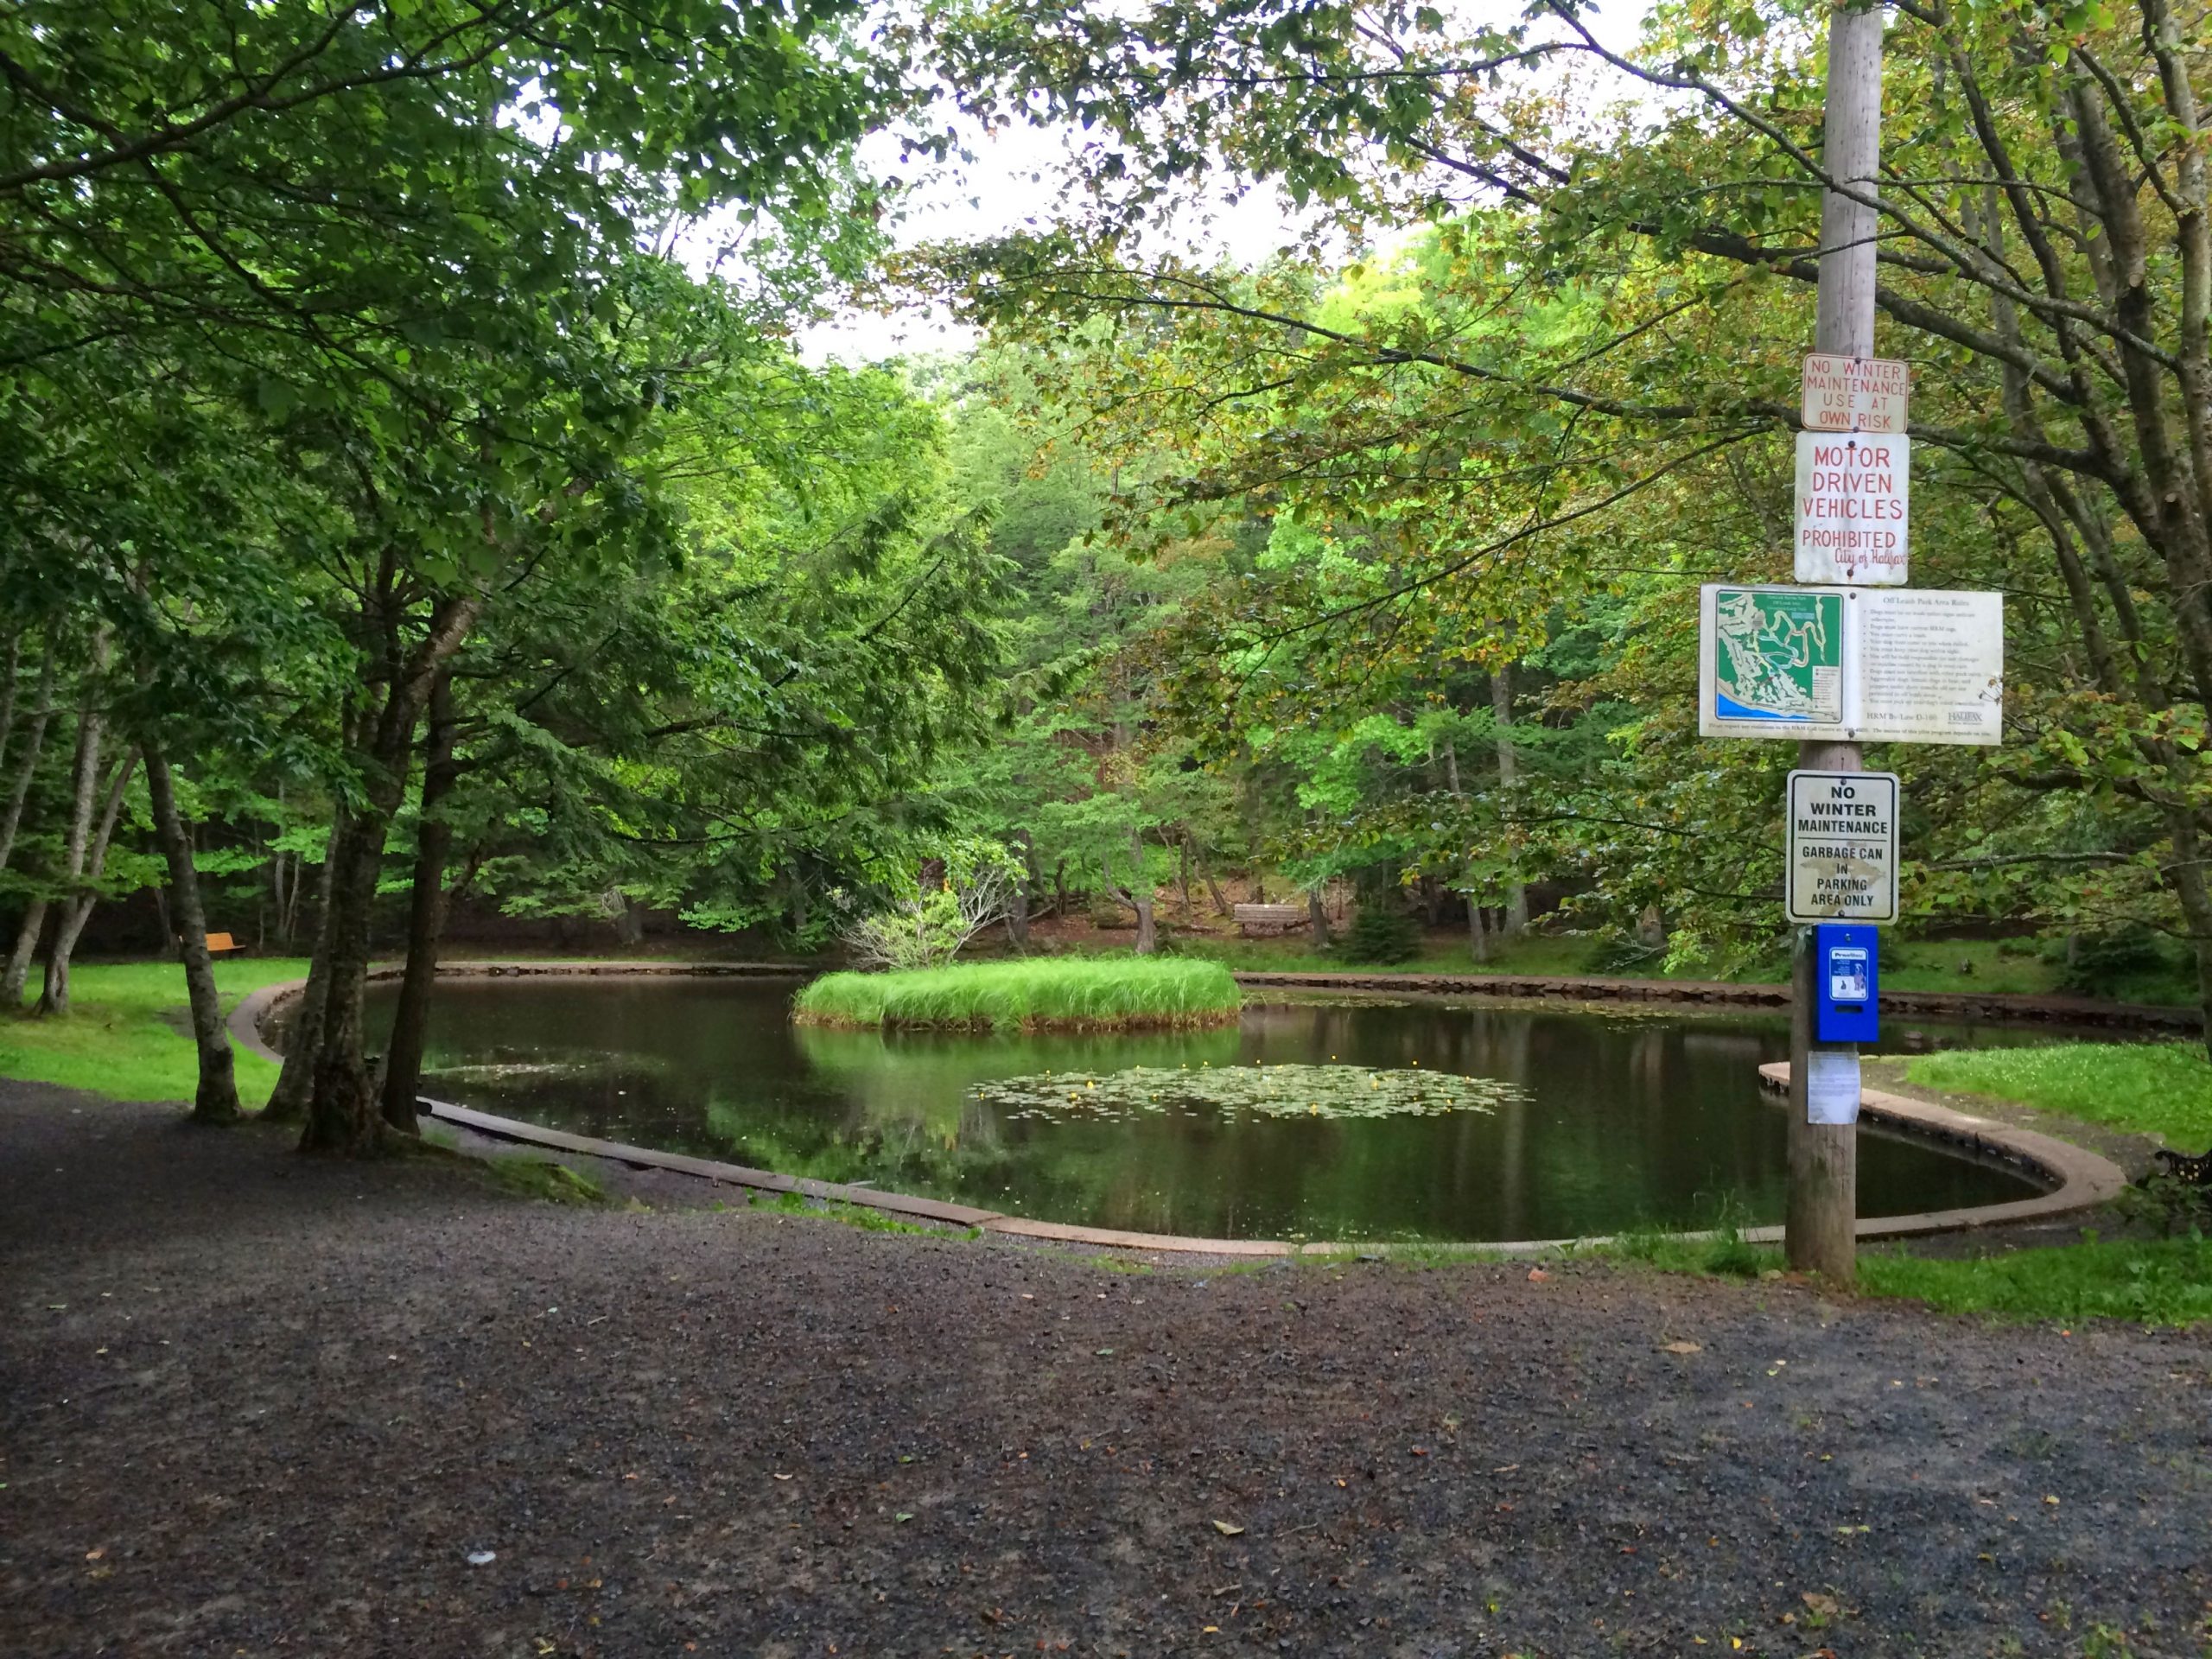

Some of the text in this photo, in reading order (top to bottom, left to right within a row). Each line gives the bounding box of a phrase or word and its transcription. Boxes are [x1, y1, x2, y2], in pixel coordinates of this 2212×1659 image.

[1811, 360, 1901, 379] NO WINTER
[1807, 376, 1905, 396] MAINTENANCE
[1823, 394, 1888, 410] USE AT
[1819, 410, 1891, 429] OWN RISK
[1815, 447, 1890, 468] MOTOR
[1813, 472, 1891, 493] DRIVEN
[1802, 497, 1903, 519] VEHICLES
[1802, 530, 1896, 548] PROHIBITED
[1834, 547, 1906, 569] City of Halifax
[1948, 711, 1984, 721] HALIFAX
[1831, 786, 1856, 799] NO
[1810, 803, 1877, 817] WINTER
[1798, 819, 1888, 835] MAINTENANCE
[1802, 846, 1883, 860] GARBAGE CAN
[1836, 863, 1848, 874] IN
[1817, 878, 1867, 891] PARKING
[1811, 893, 1874, 907] AREA ONLY
